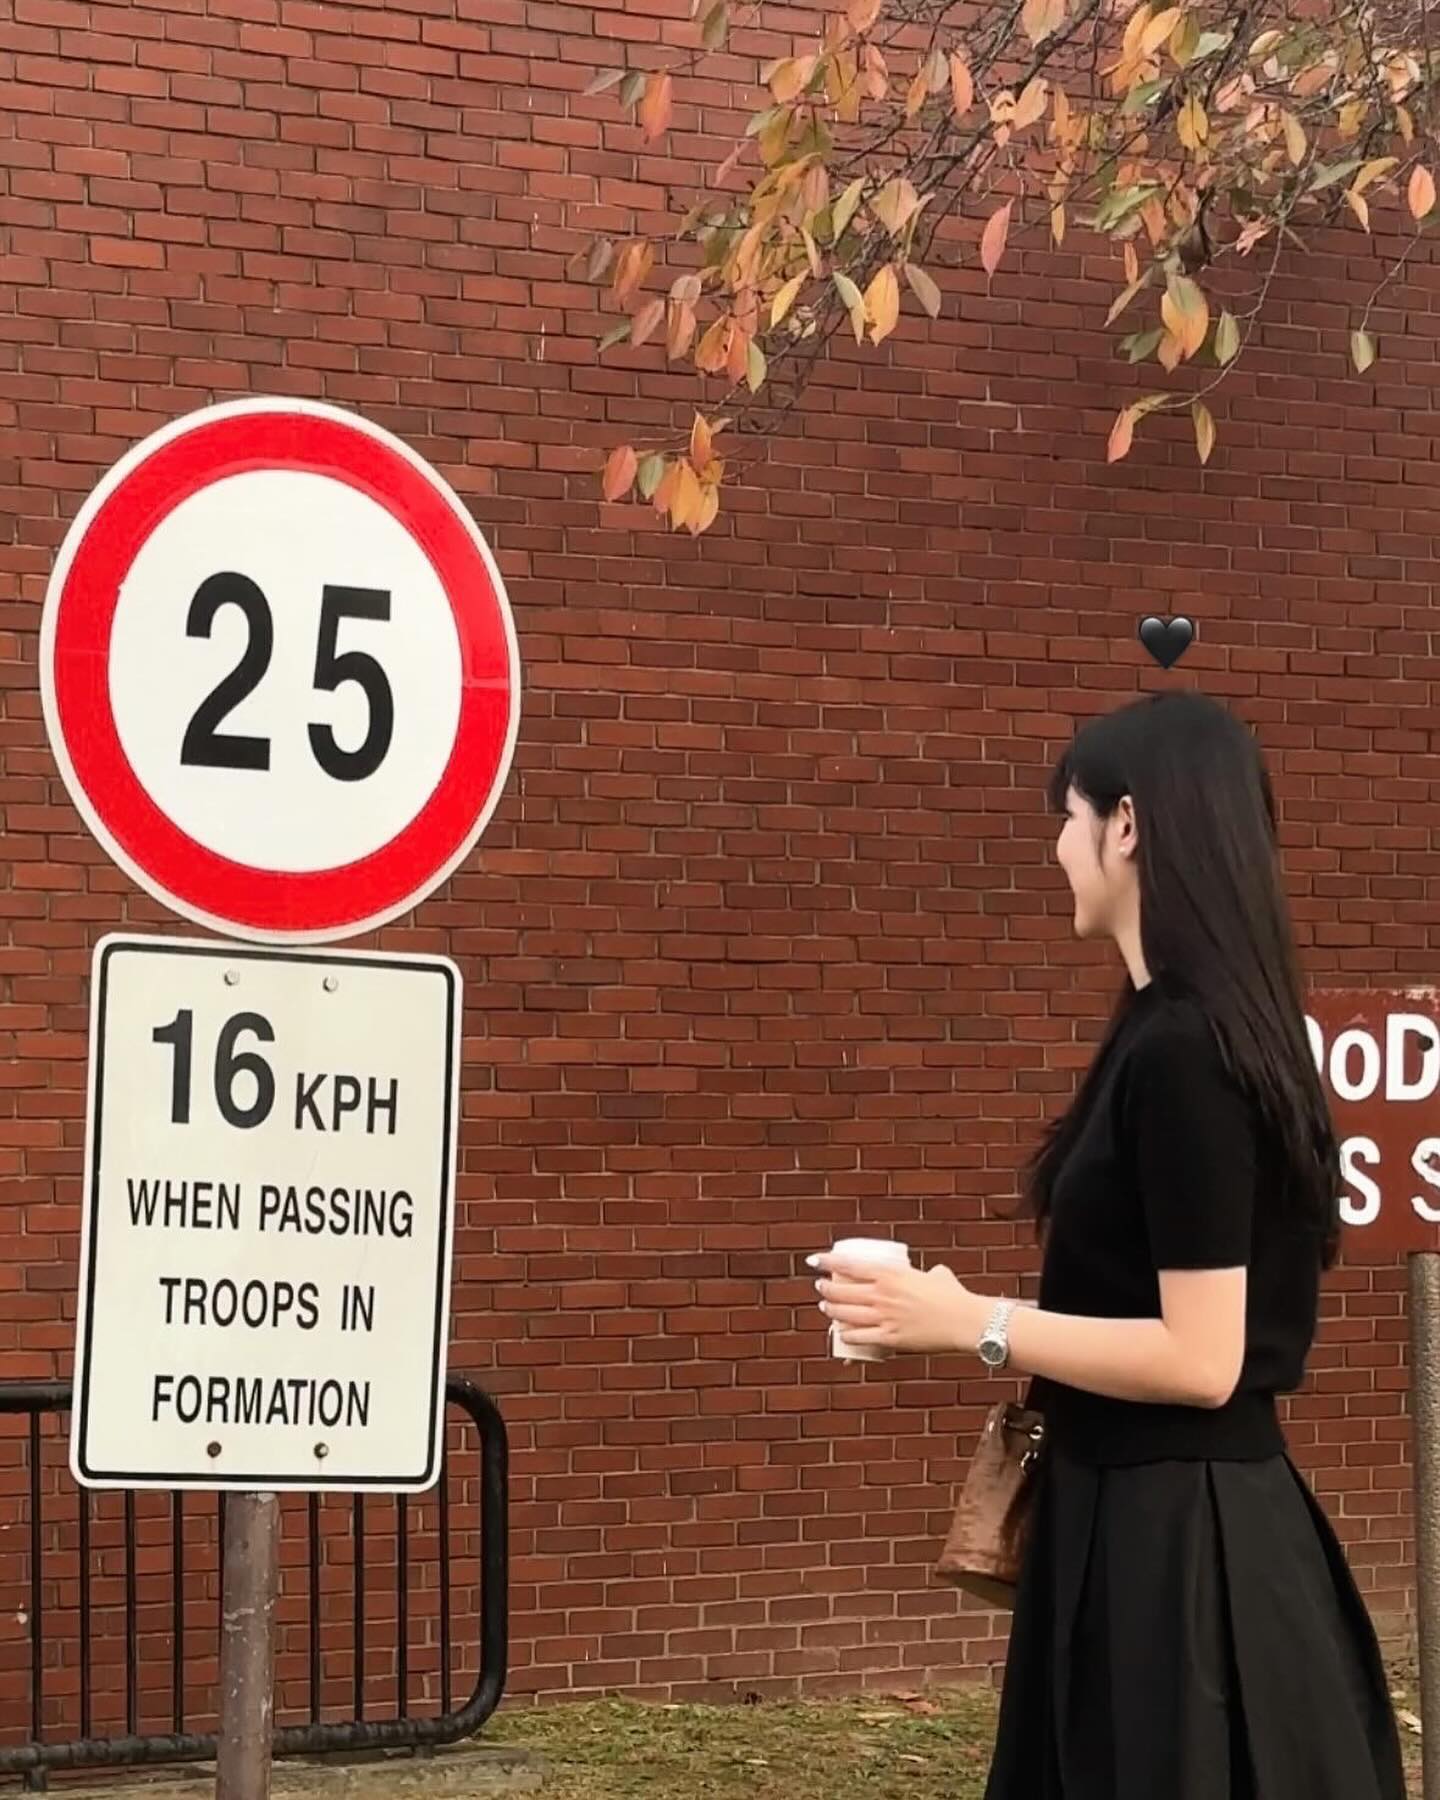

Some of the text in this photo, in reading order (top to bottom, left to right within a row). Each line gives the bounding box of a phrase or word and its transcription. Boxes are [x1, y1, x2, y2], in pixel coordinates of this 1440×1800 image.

[181, 571, 394, 782] 25
[152, 1009, 398, 1135] 16 KPH
[127, 1178, 413, 1238] WHEN PASSING
[159, 1277, 375, 1332] TROOPS IN
[152, 1374, 370, 1427] FORMATION
